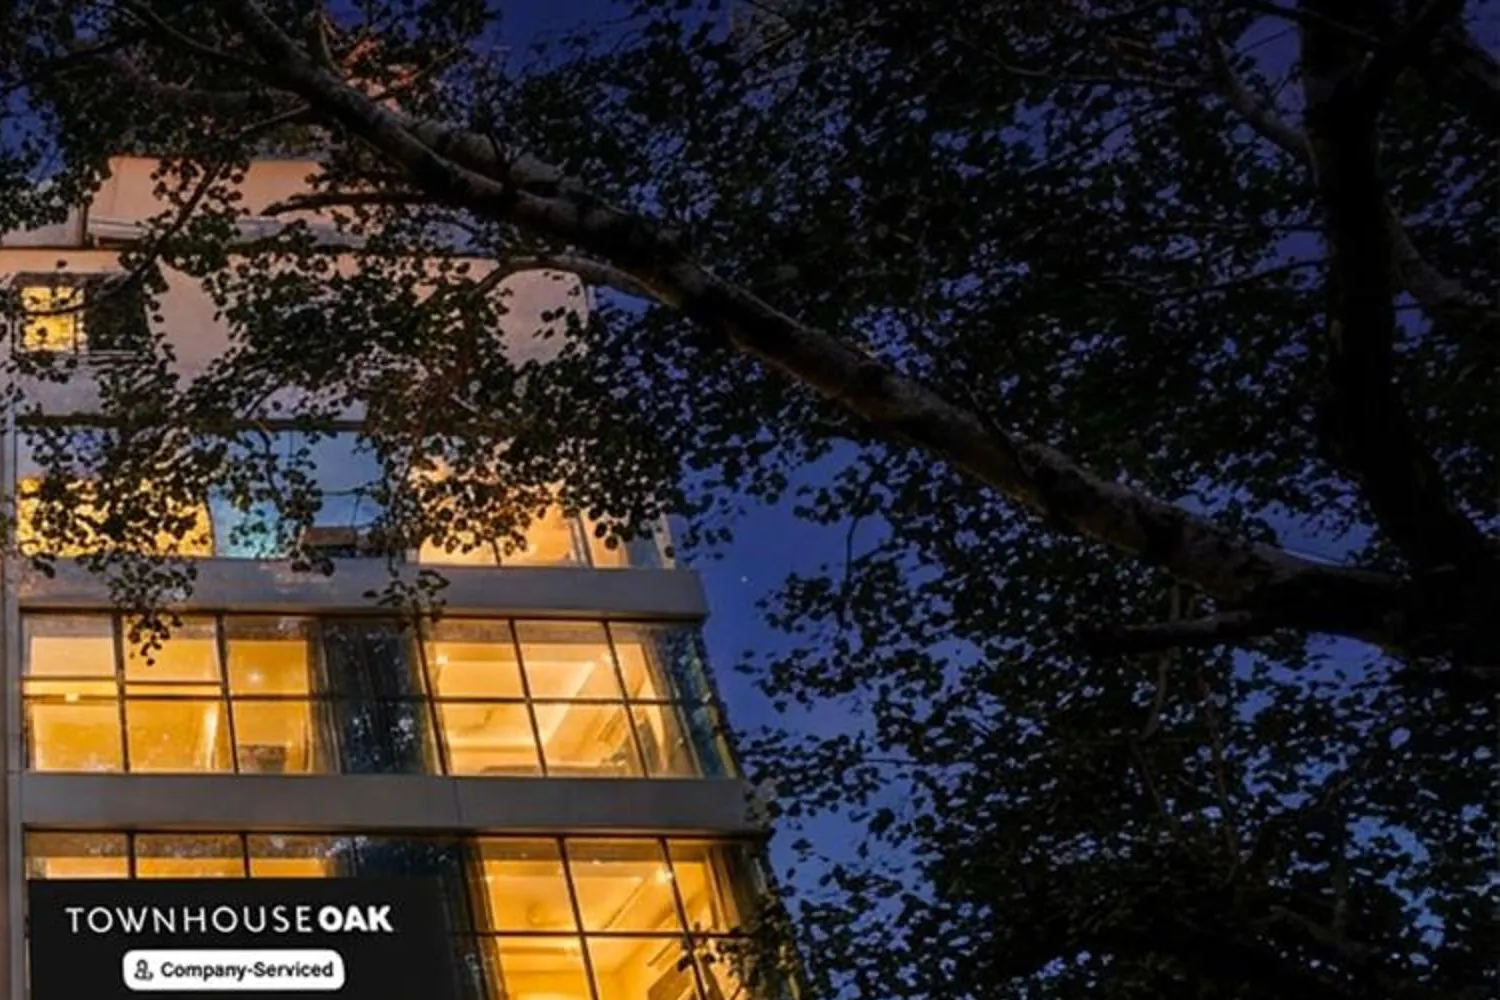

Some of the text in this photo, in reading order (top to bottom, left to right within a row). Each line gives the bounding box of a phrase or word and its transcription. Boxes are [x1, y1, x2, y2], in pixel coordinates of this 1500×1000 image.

[65, 904, 393, 933] TOWNHOUSE OAK
[160, 961, 334, 982] Company-Serviced
